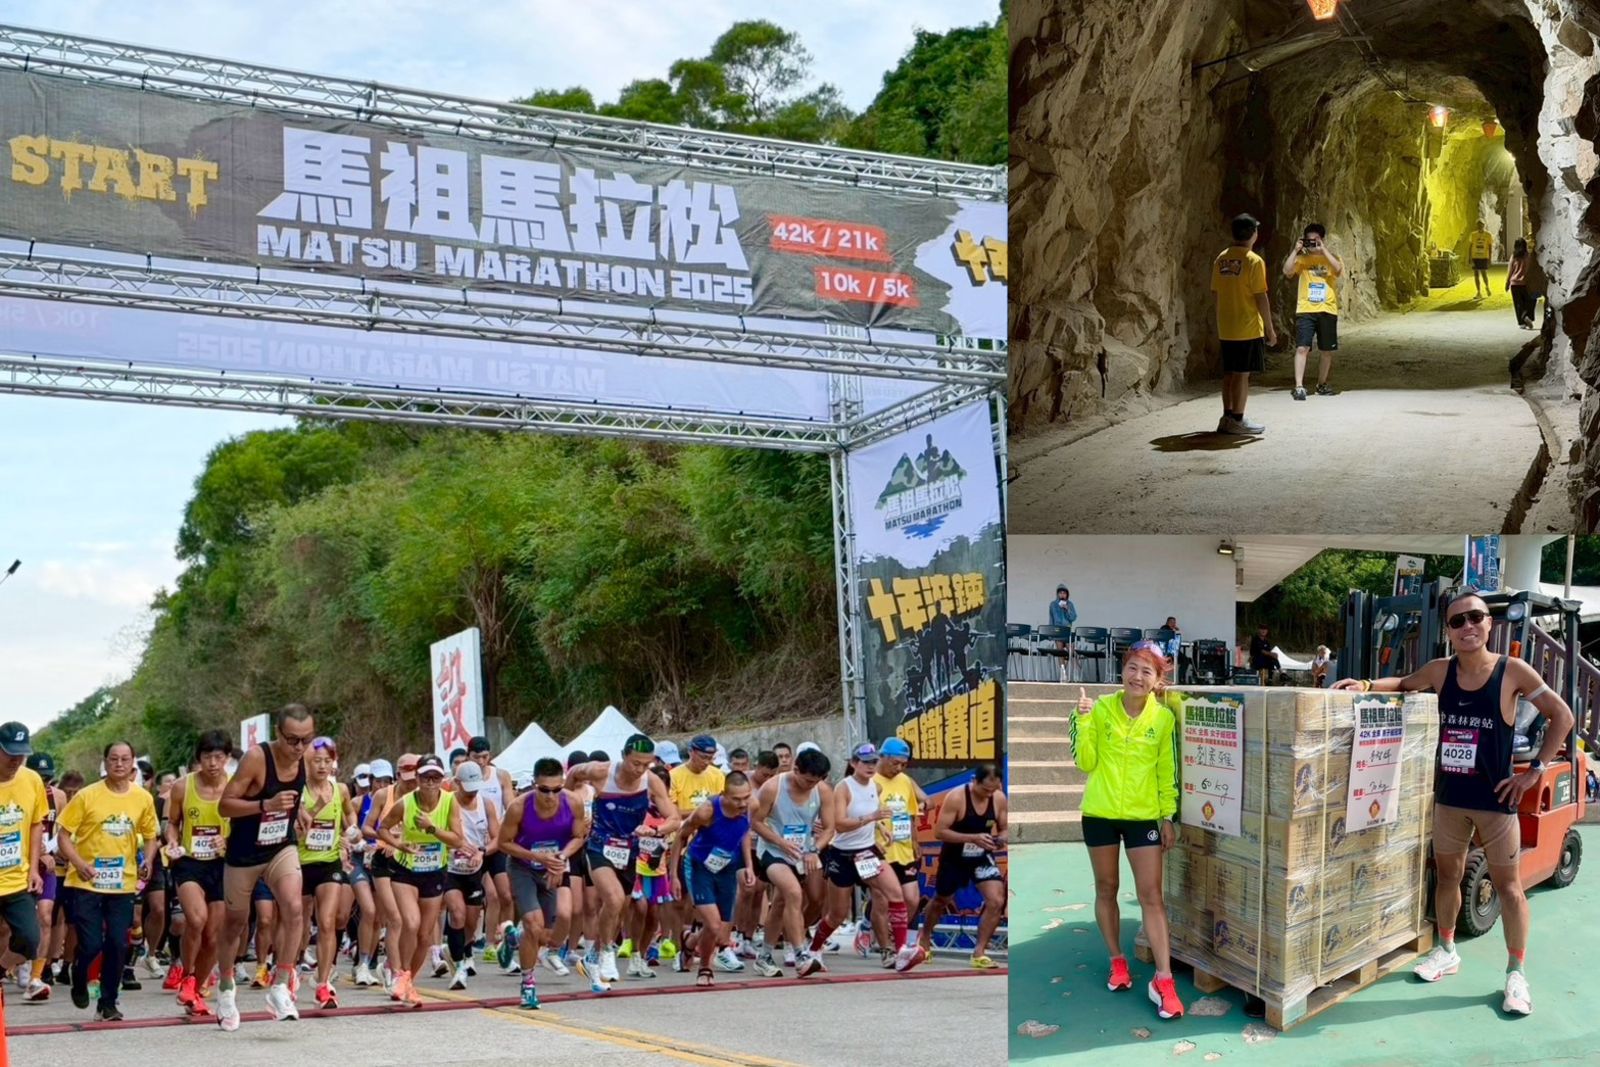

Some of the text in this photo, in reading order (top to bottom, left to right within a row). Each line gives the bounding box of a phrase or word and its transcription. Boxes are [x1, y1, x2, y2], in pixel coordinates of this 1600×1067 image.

[9, 133, 218, 214] START
[257, 126, 749, 271] 馬祖馬拉松
[774, 221, 816, 246] 42k
[838, 227, 879, 251] 21k
[257, 224, 754, 305] MATSU MARATHON 2025
[821, 270, 861, 294] 10k
[883, 278, 910, 299] 5k
[885, 498, 962, 530] MATSU MARATHON
[1443, 748, 1473, 760] 4028
[261, 823, 286, 835] 4028
[309, 833, 332, 842] 4019
[0, 846, 19, 857] 047
[604, 849, 628, 861] 4062
[414, 855, 438, 863] 2054
[95, 871, 120, 880] 2043
